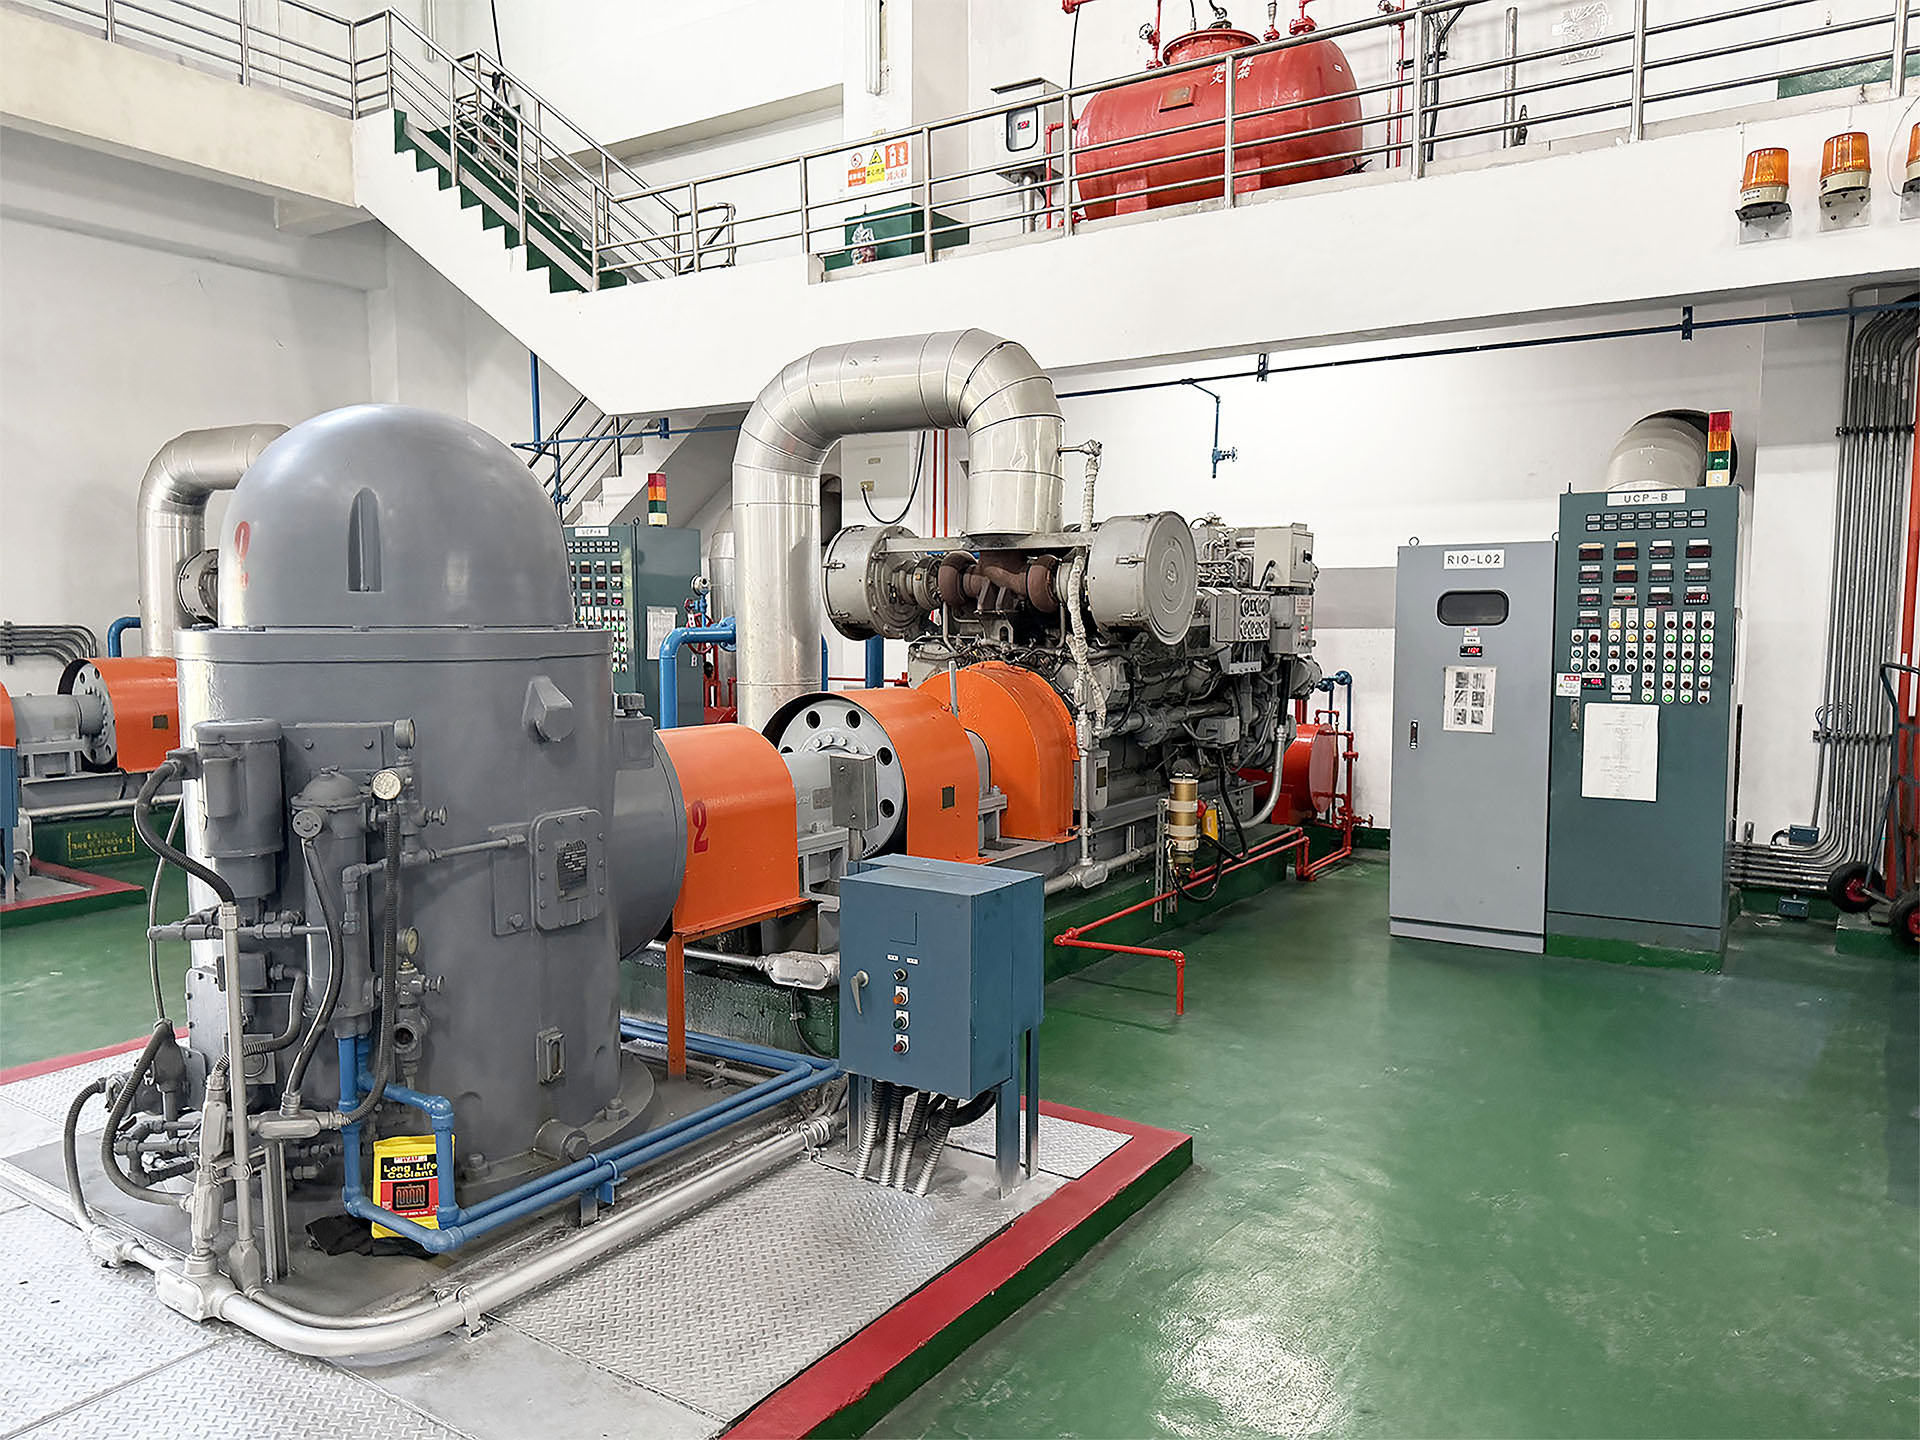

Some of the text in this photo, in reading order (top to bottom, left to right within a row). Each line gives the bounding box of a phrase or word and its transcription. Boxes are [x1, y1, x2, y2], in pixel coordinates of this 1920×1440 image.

[1623, 492, 1669, 504] UCP-B
[691, 799, 709, 854] 2
[383, 1164, 411, 1173] Long
[387, 1169, 434, 1179] Coolant
